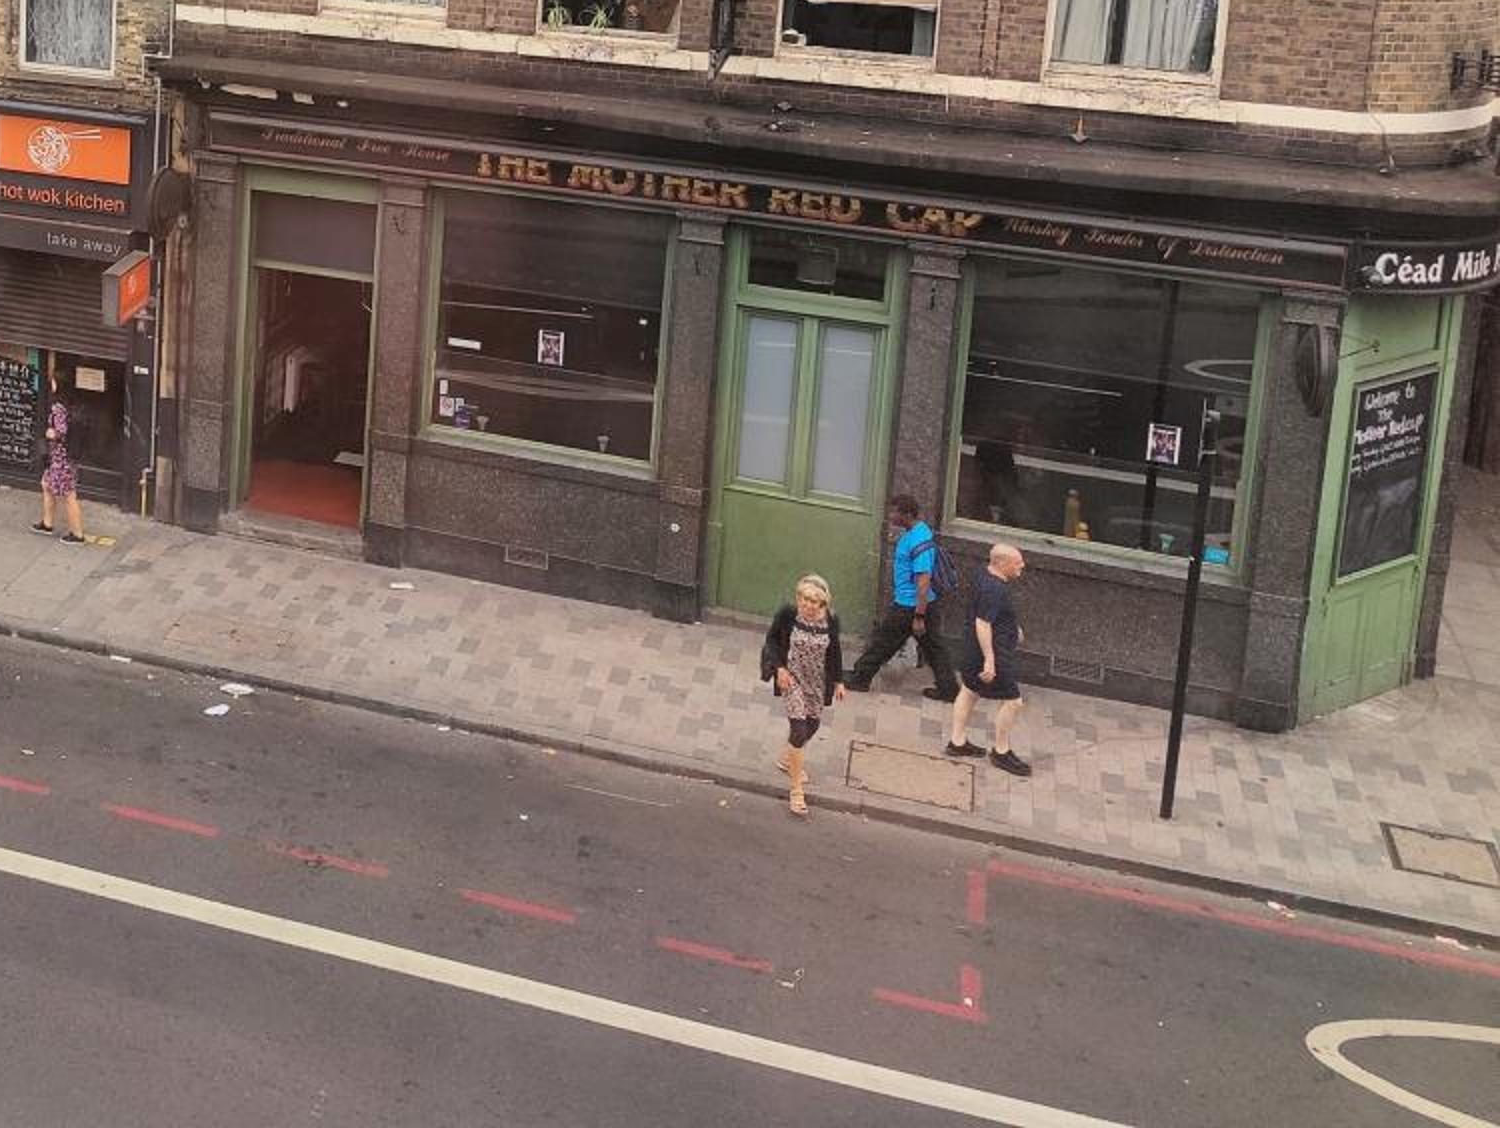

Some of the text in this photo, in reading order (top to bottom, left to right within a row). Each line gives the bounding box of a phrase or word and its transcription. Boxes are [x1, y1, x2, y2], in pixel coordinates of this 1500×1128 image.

[27, 185, 62, 205] wok
[66, 189, 125, 213] kitchen
[476, 151, 551, 184] THE
[566, 165, 749, 209] MOTHER
[768, 188, 862, 224] RED
[47, 232, 122, 256] take away
[1375, 252, 1445, 285] Céad
[1451, 249, 1491, 282] Mile
